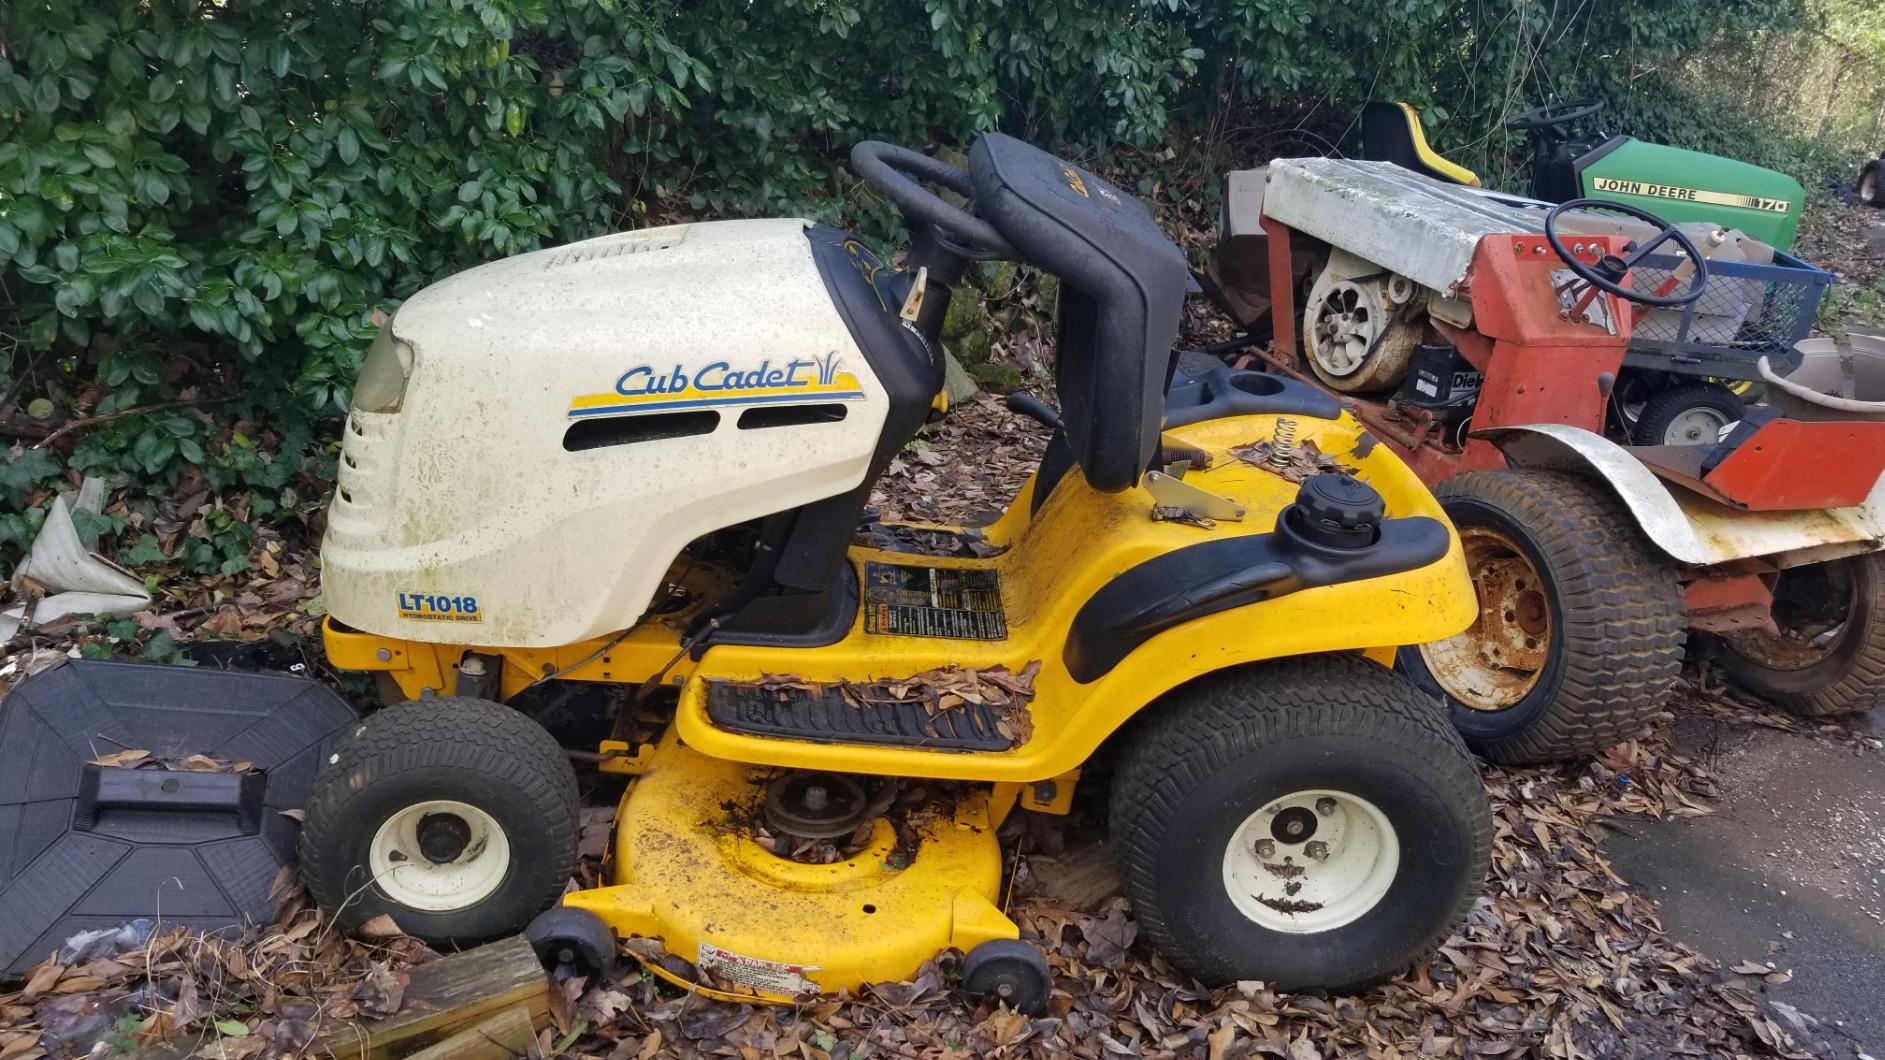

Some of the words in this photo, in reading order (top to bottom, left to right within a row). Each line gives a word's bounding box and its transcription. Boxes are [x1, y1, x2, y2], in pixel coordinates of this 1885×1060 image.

[1599, 179, 1641, 194] JOHN
[1647, 185, 1697, 200] DEERE
[1758, 197, 1788, 213] 170
[615, 364, 688, 395] Cub
[693, 359, 815, 391] Cadet
[399, 593, 478, 613] LT1018
